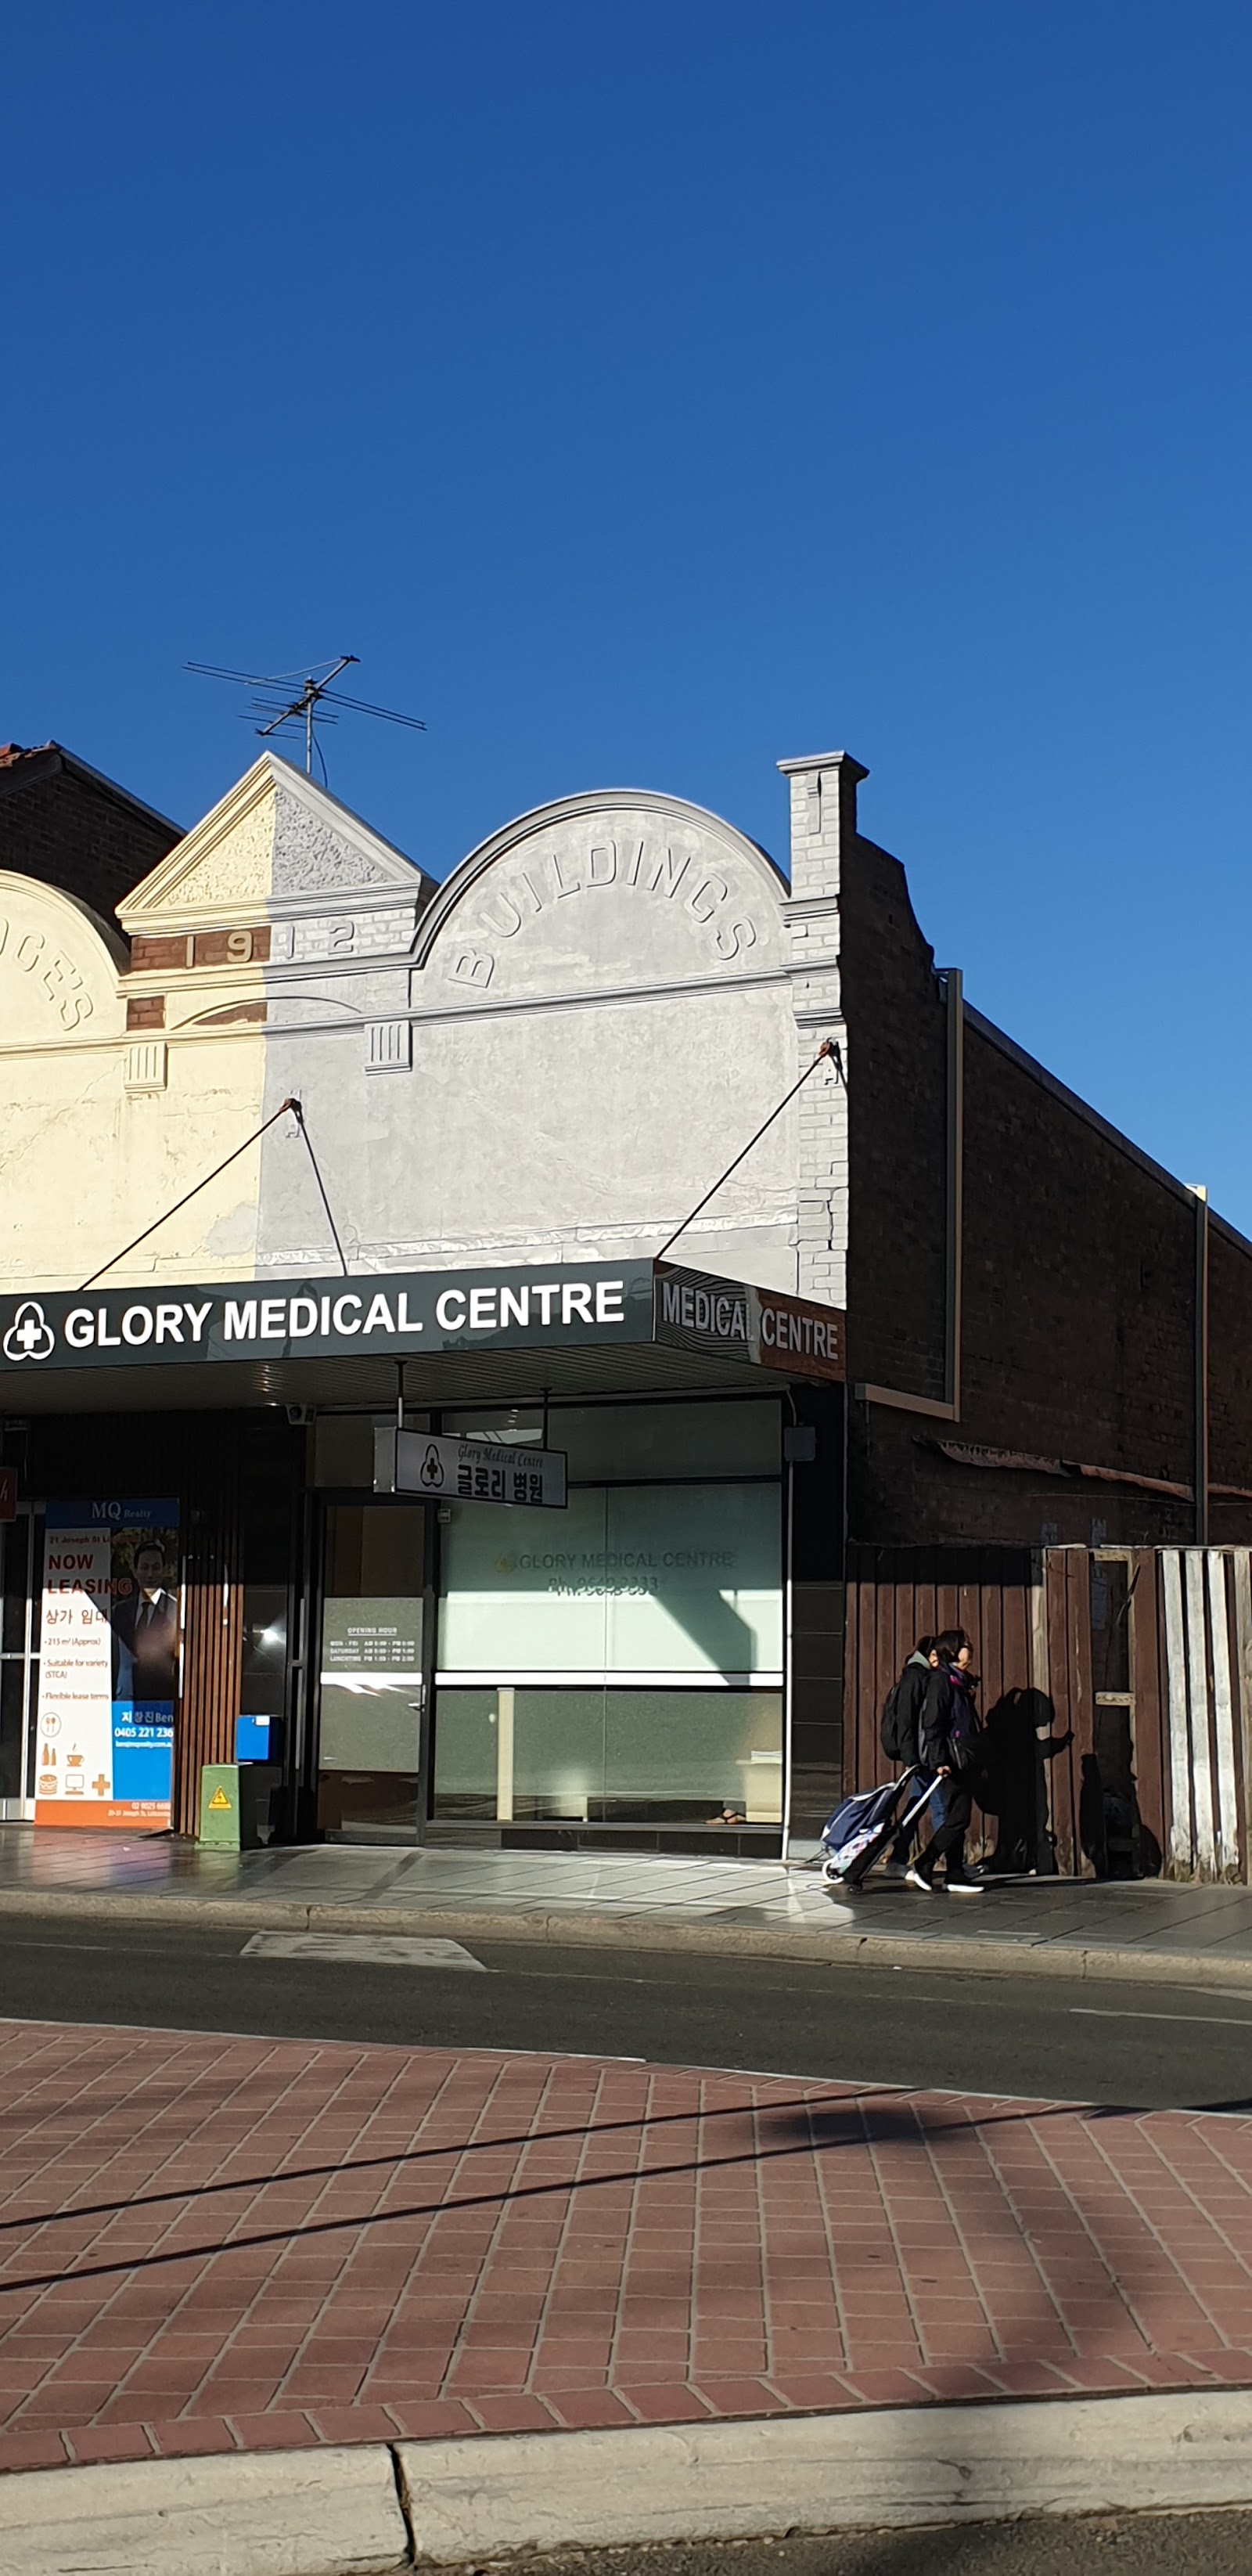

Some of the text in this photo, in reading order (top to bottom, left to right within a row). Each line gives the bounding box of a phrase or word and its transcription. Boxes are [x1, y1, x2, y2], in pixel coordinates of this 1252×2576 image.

[448, 838, 757, 989] BUILDINGS
[185, 921, 355, 968] 1912
[64, 1280, 624, 1349] GLORY MEDICAL CENTRE
[662, 1281, 839, 1360] MEDICAL CENTRE
[458, 1444, 544, 1468] Glory Medical Centre
[458, 1464, 543, 1504] 글로리 병원
[91, 1501, 153, 1521] MQ Realty
[48, 1554, 94, 1571] NOW
[519, 1551, 733, 1569] GLORY MEDICAL CENTRE
[47, 1577, 133, 1595] LEASING
[46, 1609, 108, 1625] 상가 임대
[47, 1659, 74, 1667] Suitable
[86, 1659, 108, 1668] variety
[72, 1692, 90, 1700] lease
[155, 1712, 174, 1724] Ben
[114, 1727, 174, 1738] 0405 221 236
